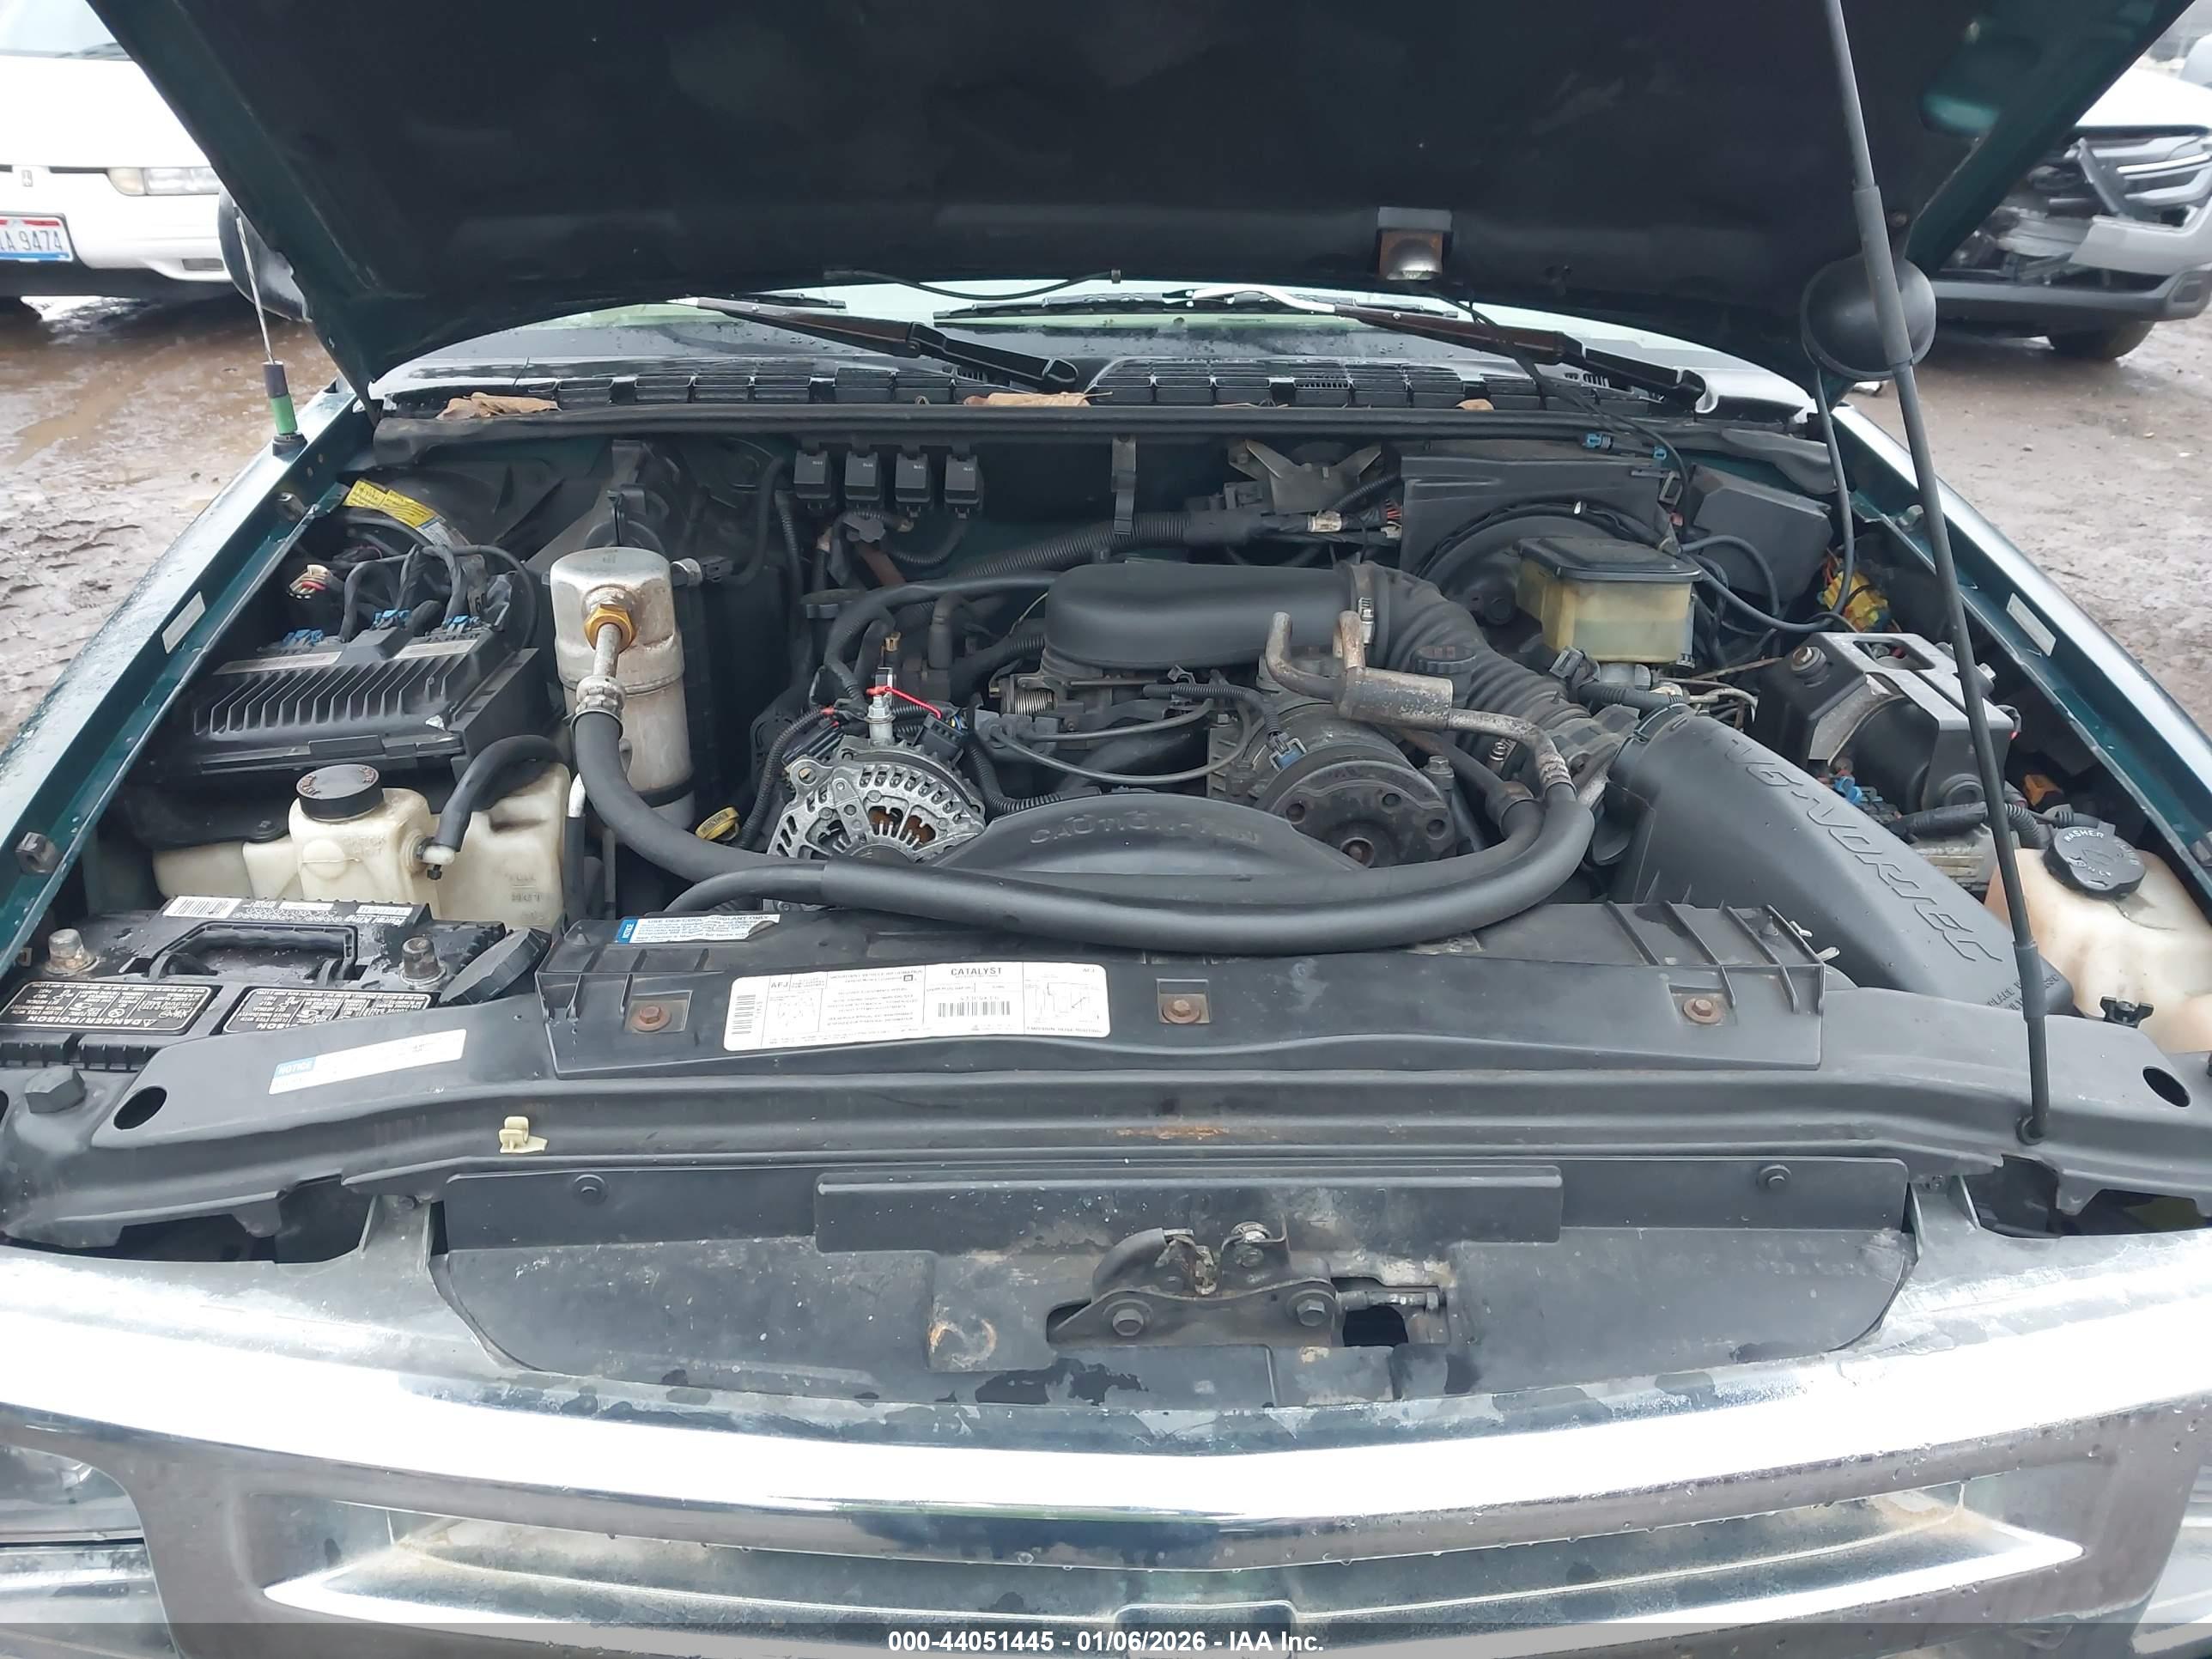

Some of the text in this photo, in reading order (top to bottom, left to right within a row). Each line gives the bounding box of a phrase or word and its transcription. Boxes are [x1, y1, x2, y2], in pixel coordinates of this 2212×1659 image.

[18, 230, 63, 252] 9474
[2063, 830, 2105, 842] WASHER
[343, 915, 406, 925] Rural King
[951, 967, 1003, 976] CATALYST
[770, 981, 789, 989] AFJ
[26, 1016, 143, 1026] DANGER/POISON
[278, 1060, 312, 1074] NOTICE
